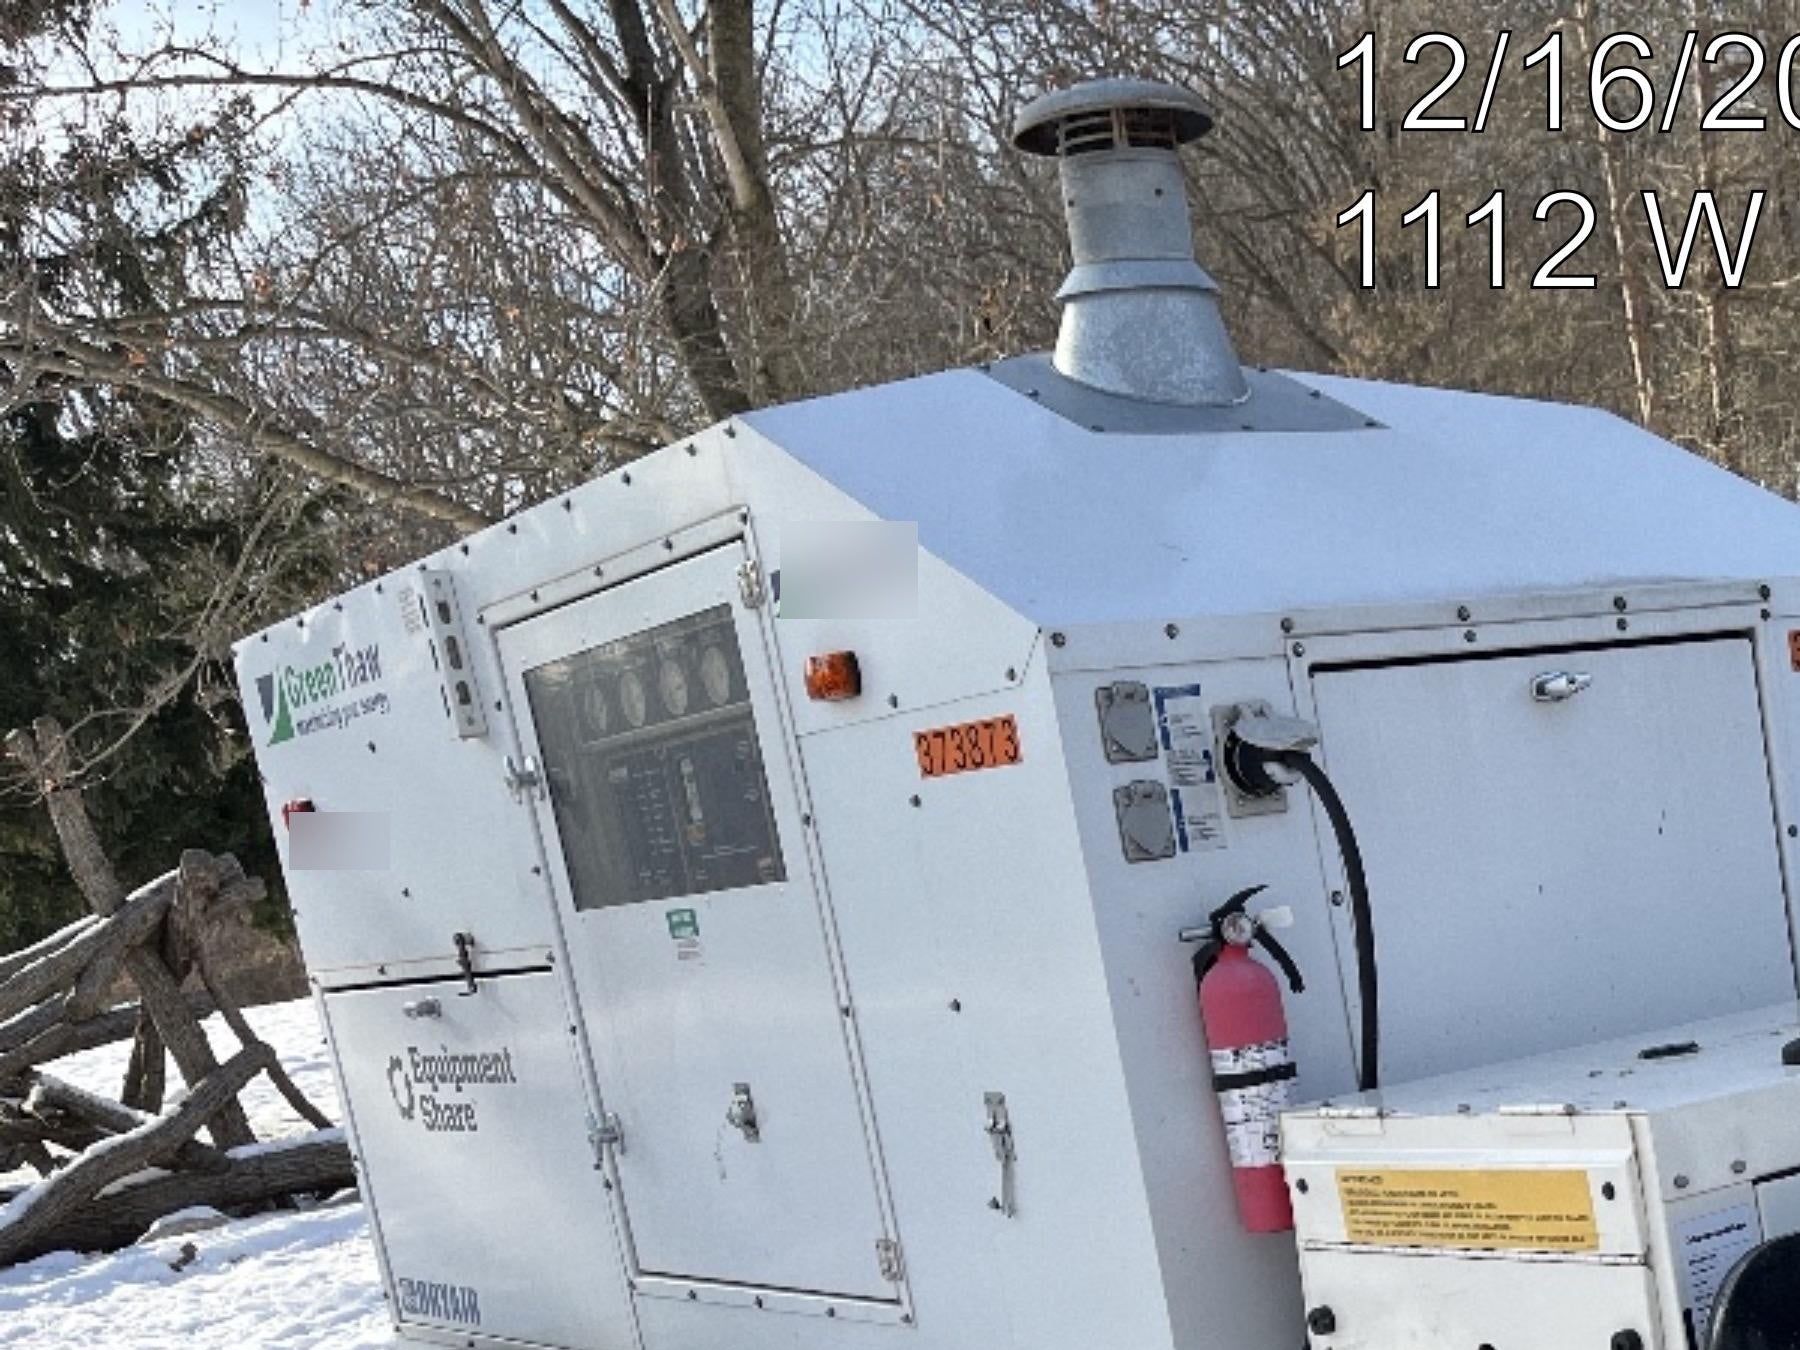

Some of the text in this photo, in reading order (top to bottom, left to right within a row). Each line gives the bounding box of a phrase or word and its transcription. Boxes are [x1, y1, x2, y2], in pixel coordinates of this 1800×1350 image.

[916, 719, 1020, 776] 373873
[407, 1043, 517, 1093] Equipment
[419, 1094, 478, 1132] Share
